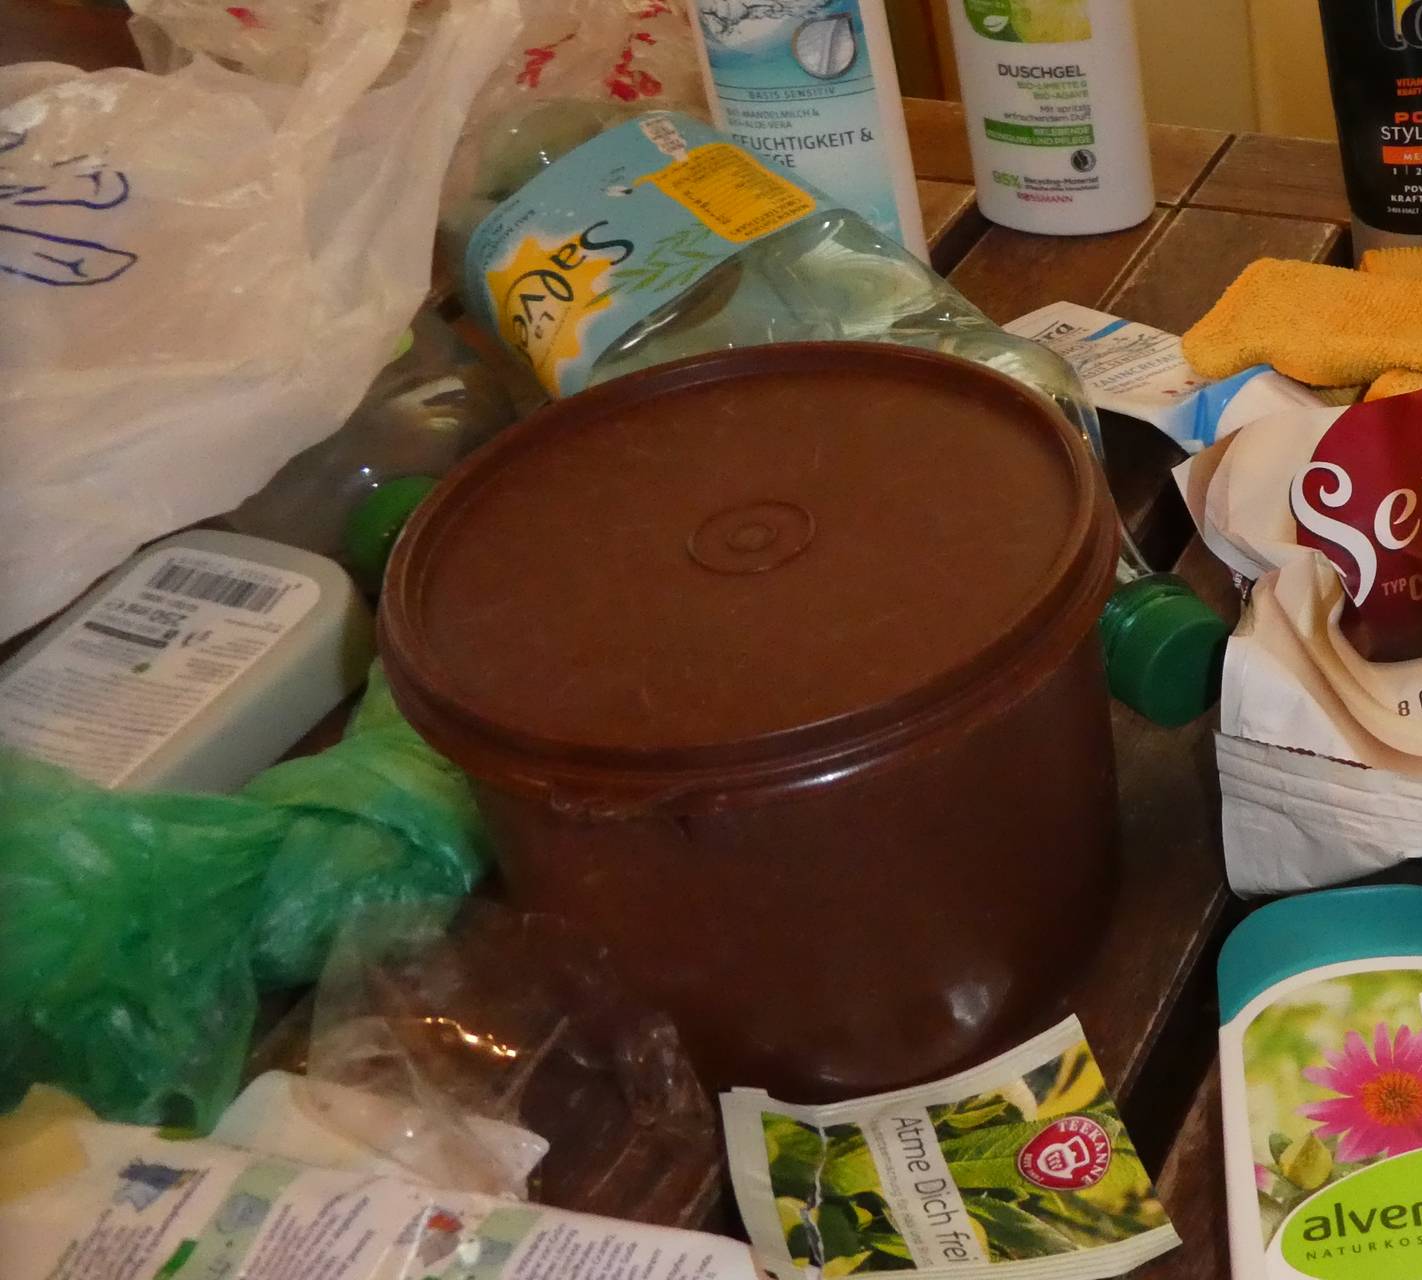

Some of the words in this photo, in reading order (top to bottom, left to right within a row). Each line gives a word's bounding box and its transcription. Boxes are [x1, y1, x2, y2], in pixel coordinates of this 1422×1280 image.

[998, 63, 1086, 79] DUSCHGEL
[861, 127, 874, 143] &
[1381, 578, 1408, 597] TYP
[1397, 701, 1410, 718] 8
[891, 1117, 931, 1172] Atme
[1057, 1118, 1108, 1186] TEEKANNE
[914, 1178, 959, 1226] Dich
[935, 1230, 979, 1262] frei
